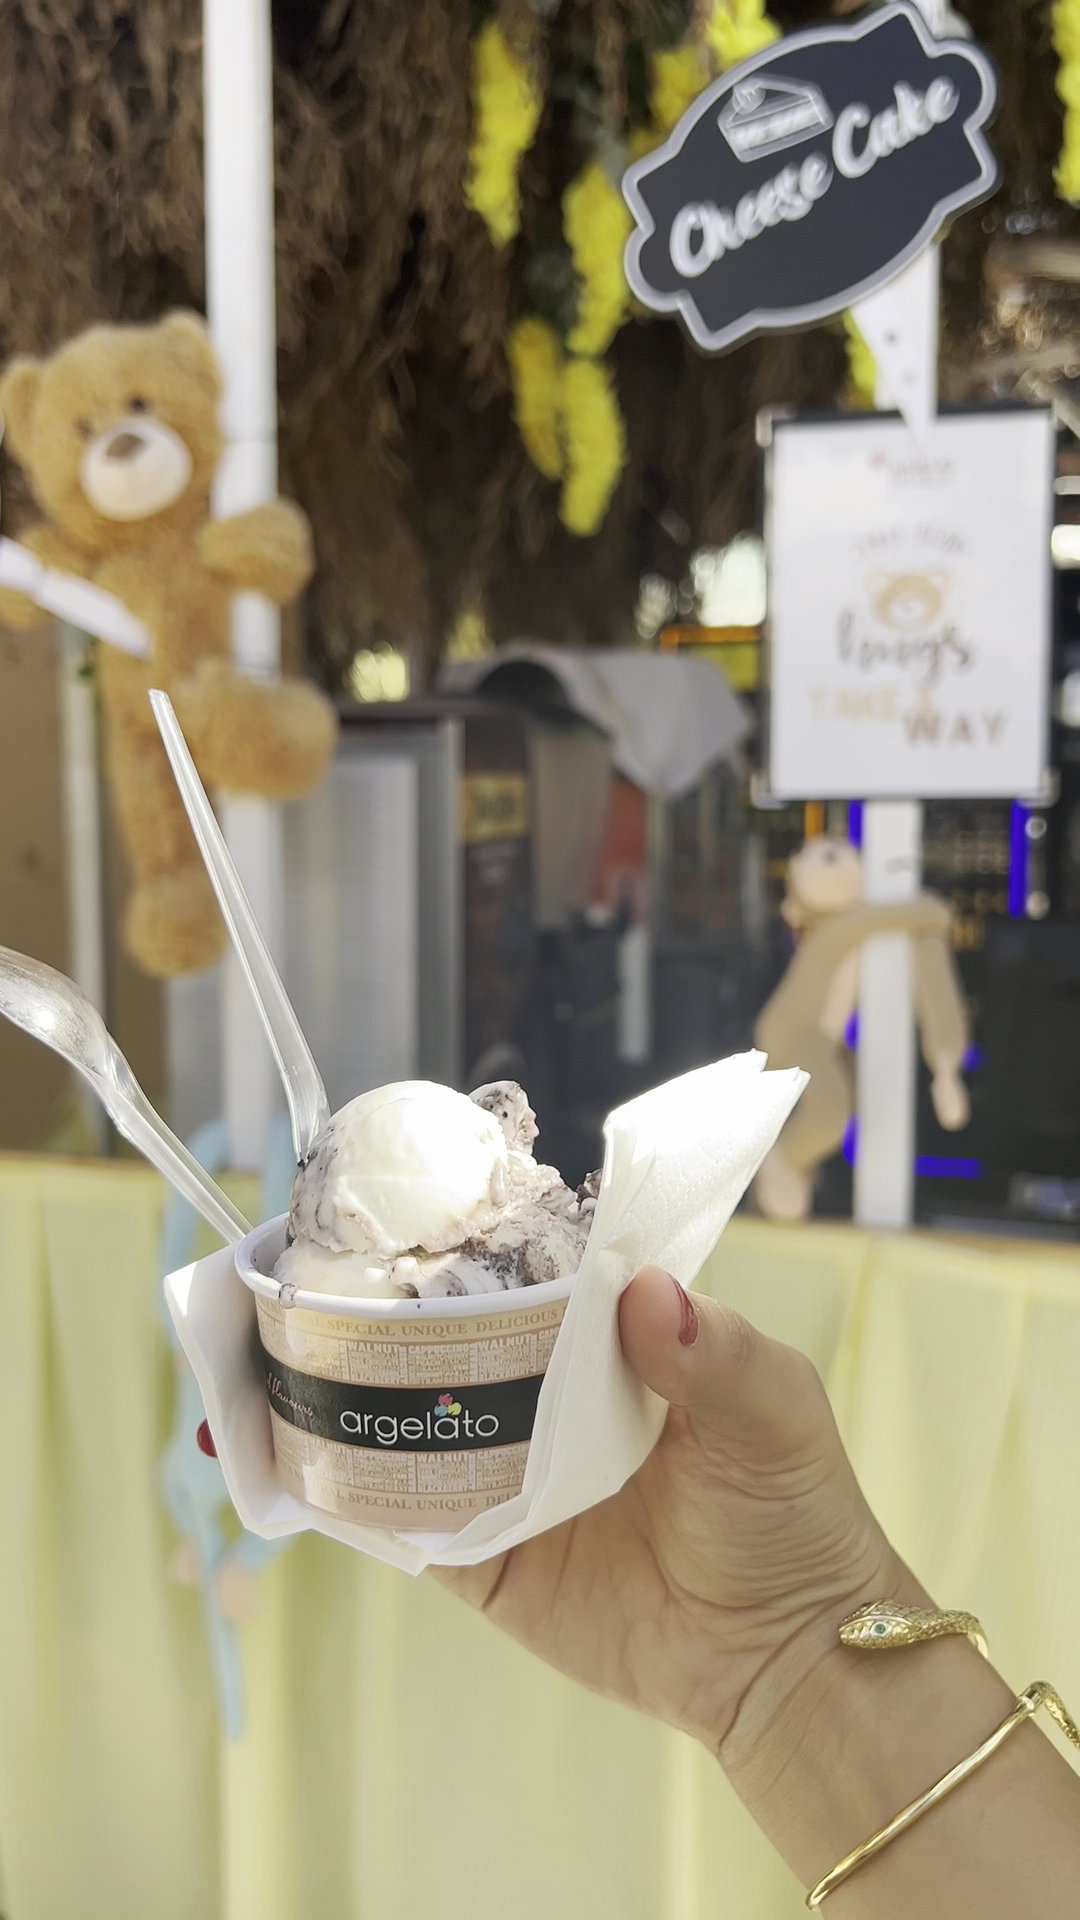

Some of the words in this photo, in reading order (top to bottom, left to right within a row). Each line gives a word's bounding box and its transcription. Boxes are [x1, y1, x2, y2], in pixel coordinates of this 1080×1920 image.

[670, 152, 834, 278] Cheese
[832, 76, 960, 178] Cake
[902, 710, 1010, 749] WAY
[328, 1319, 396, 1336] SPECIAL
[401, 1323, 468, 1338] UNIQUE
[476, 1309, 558, 1332] DELICIOUS
[479, 1334, 530, 1351] WALNUT
[340, 1409, 499, 1445] argelato
[348, 1492, 412, 1509] SPECIAL
[416, 1497, 477, 1512] UNIQUE
